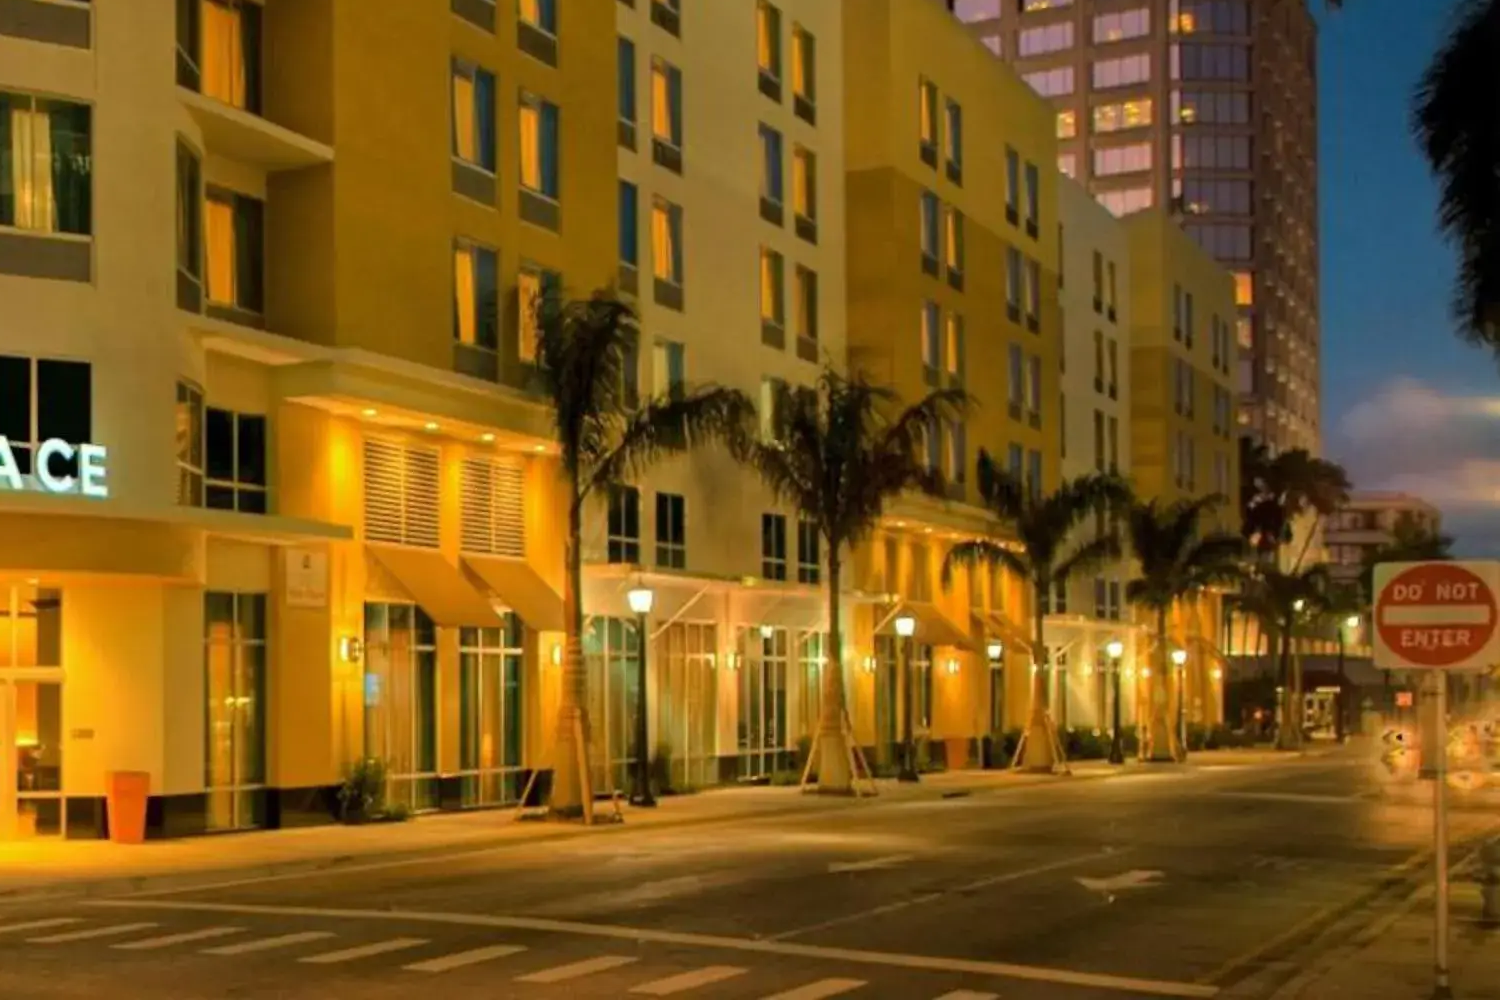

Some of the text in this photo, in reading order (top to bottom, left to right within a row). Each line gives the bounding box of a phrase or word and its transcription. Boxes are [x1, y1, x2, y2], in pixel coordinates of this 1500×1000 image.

[1392, 582, 1479, 601] DO NOT
[1401, 628, 1471, 648] ENTER
